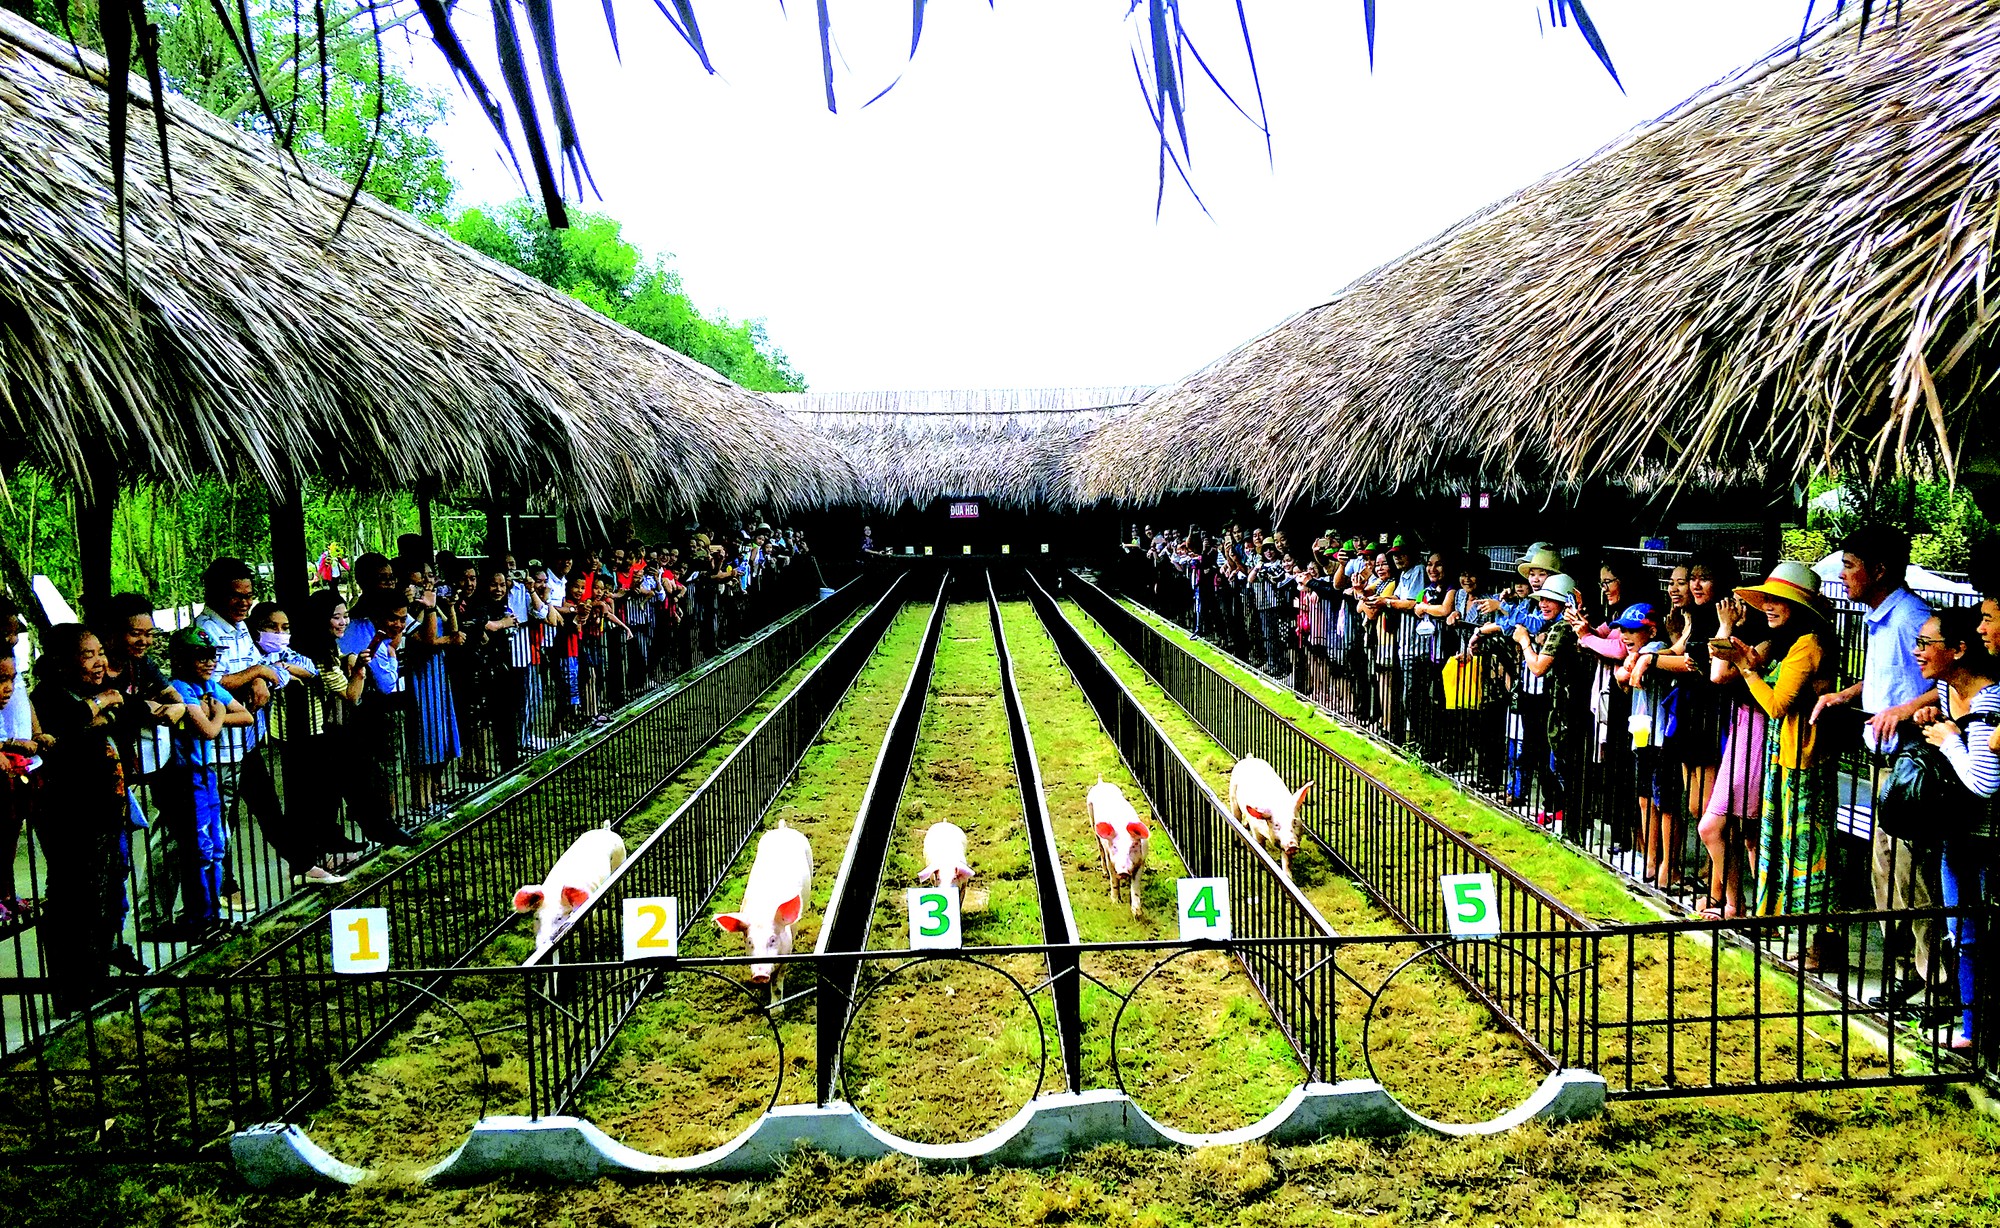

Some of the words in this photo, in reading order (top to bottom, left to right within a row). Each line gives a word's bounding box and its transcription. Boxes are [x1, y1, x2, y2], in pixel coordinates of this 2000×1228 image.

[965, 504, 979, 516] HEO
[919, 893, 951, 937] 3
[1188, 886, 1221, 928] 4
[1454, 882, 1487, 924] 5
[347, 917, 380, 961] 1
[636, 905, 669, 949] 2
